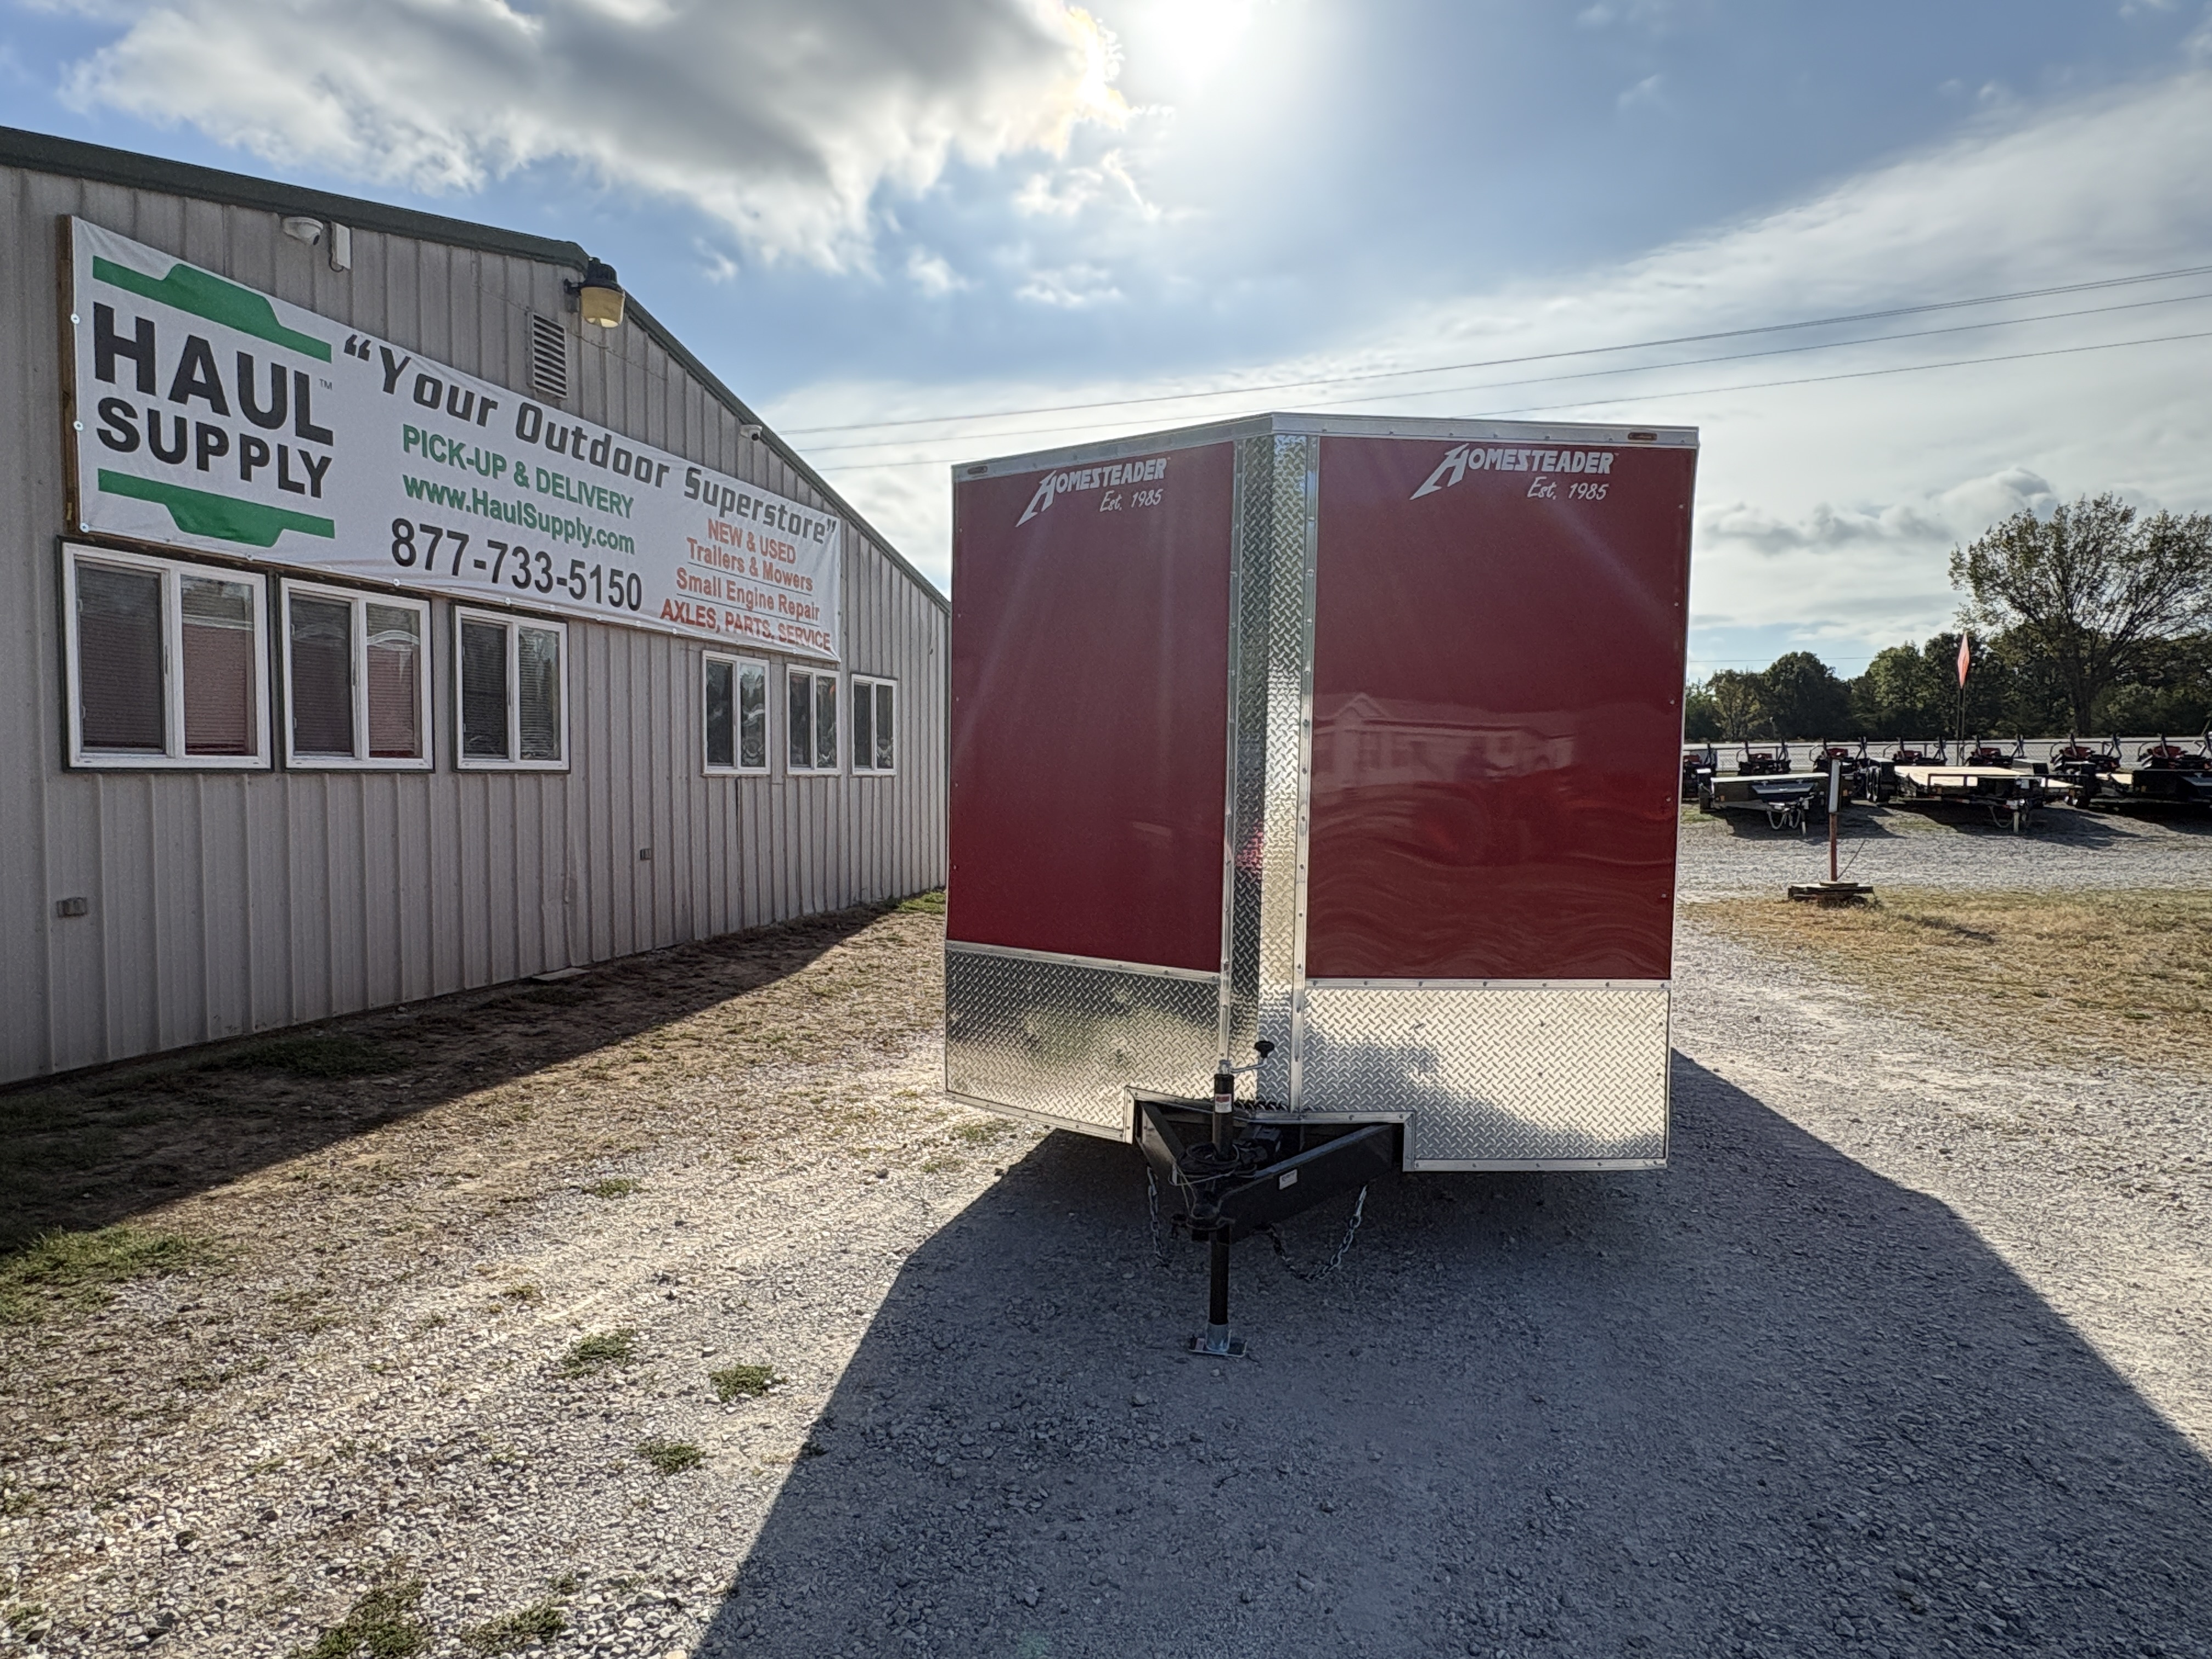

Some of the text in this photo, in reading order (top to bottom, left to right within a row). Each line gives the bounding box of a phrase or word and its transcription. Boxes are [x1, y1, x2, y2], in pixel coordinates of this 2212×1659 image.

[93, 302, 333, 446] HAUL
[97, 398, 332, 498] SUPPLY
[403, 424, 634, 518] PICK-UP & DELIVERY
[516, 402, 669, 488] Outdoor
[1409, 443, 1614, 500] HOMESTEADER
[403, 475, 635, 554] www.HaulSupply.com
[1015, 458, 1167, 528] HOMESTEADER
[1100, 489, 1163, 512] Est. 1985
[1527, 477, 1608, 500] Est. 1985
[392, 518, 642, 611] 877-733-5150
[687, 538, 812, 591] Trailers & Mowers
[708, 518, 796, 564] NEW & USED
[660, 599, 720, 633] AXLES,
[778, 623, 831, 651] SERVICE
[676, 567, 819, 620] Small Engine Repair
